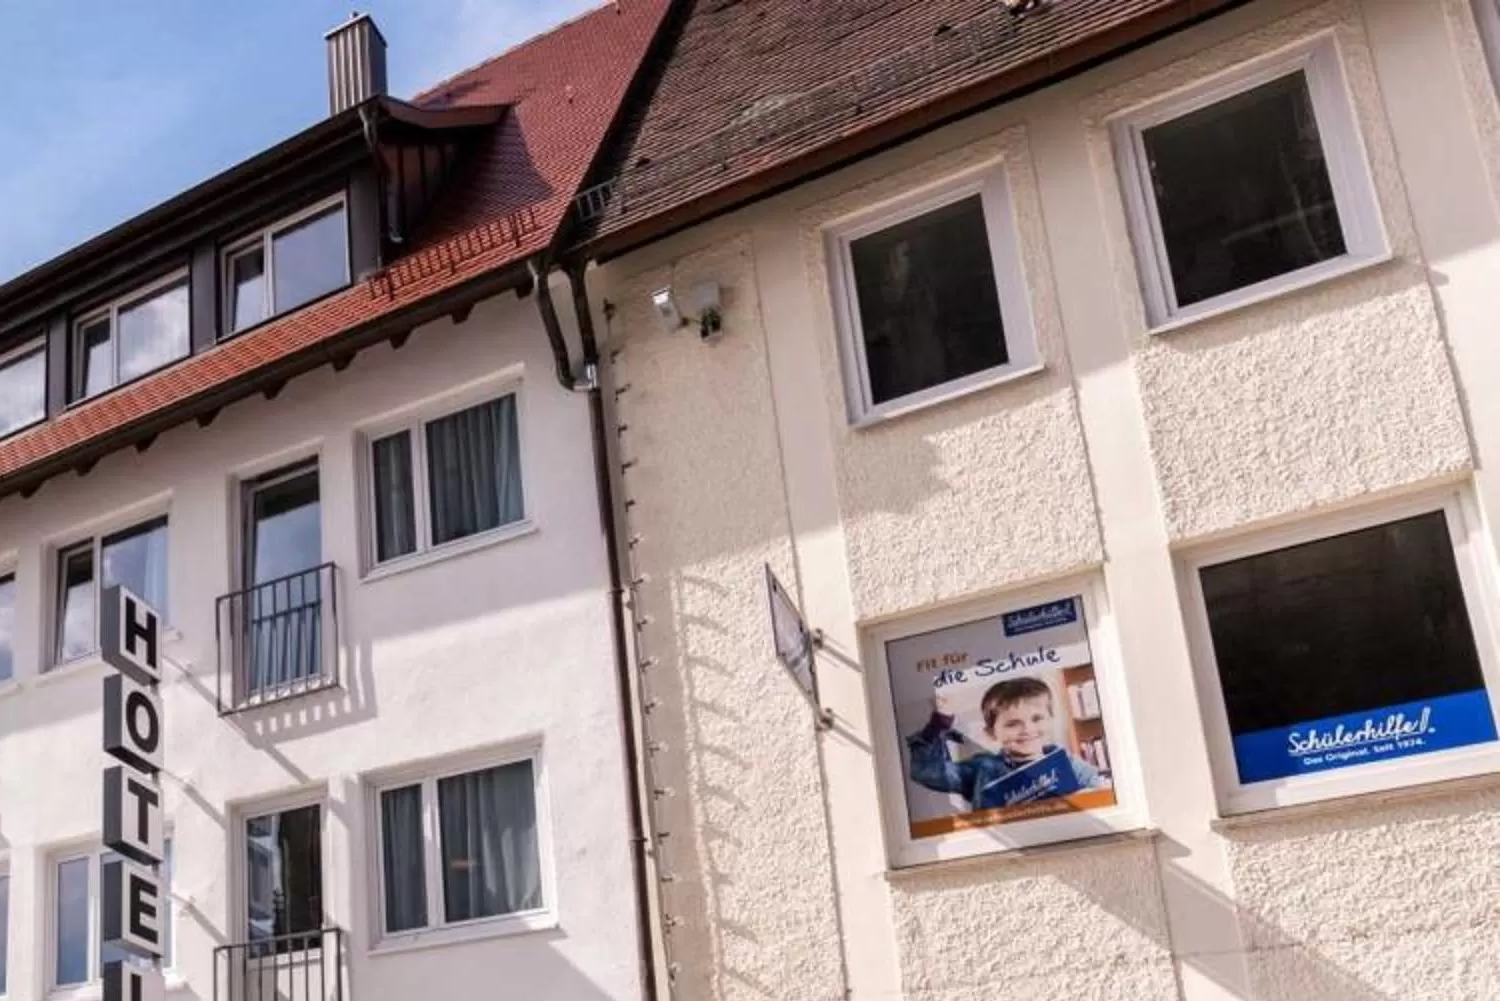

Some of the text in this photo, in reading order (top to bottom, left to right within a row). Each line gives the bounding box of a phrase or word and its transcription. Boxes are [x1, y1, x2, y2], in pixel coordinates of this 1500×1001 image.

[932, 646, 1061, 689] die Schule
[943, 651, 969, 665] für
